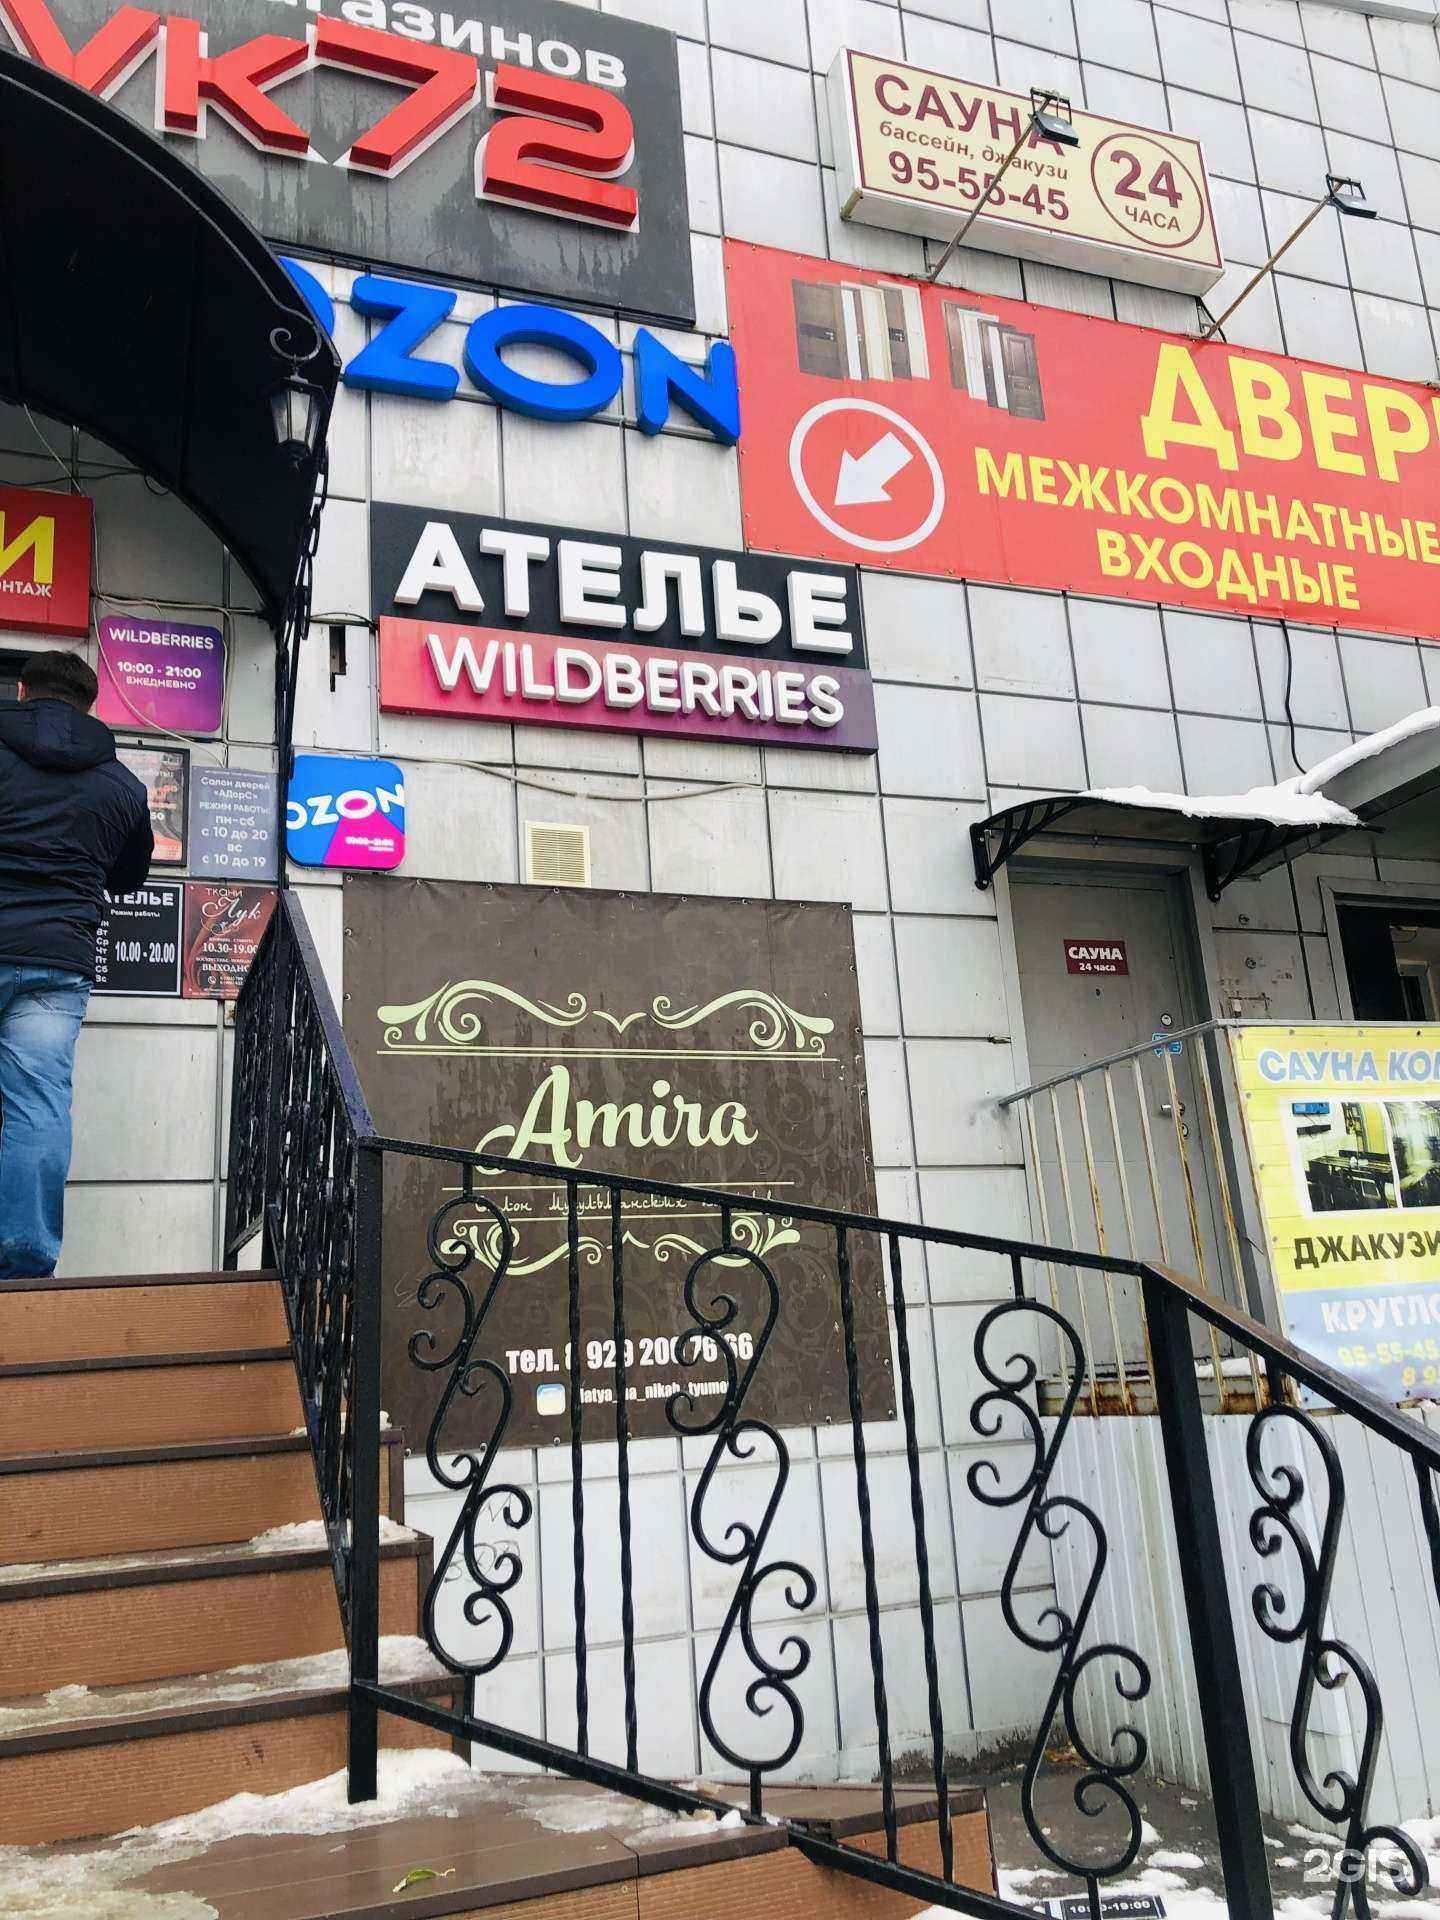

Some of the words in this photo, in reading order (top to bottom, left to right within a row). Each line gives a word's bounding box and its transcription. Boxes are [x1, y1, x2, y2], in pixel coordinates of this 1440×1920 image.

[268, 0, 627, 88] азинов
[879, 121, 975, 161] бассейн,
[982, 146, 1069, 180] джакузи
[888, 150, 1070, 221] 95-55-45
[1110, 149, 1182, 209] 24
[1125, 204, 1181, 232] ЧАСА
[974, 446, 1440, 565] МЕЖКОМНАТНЫЕ
[1096, 528, 1360, 611] ВХОДНЫЕ
[393, 520, 853, 655] АТЕЛЬЕ
[109, 627, 215, 650] WILDBERRIES
[117, 661, 154, 675] 10:00
[165, 665, 202, 679] 21:00
[126, 675, 197, 691] ЕЖЕДНЕВНО
[427, 633, 846, 728] WILDBERRIES
[200, 776, 232, 788] Салон
[213, 826, 228, 838] 10
[230, 830, 249, 842] до
[251, 829, 269, 841] 20
[213, 853, 229, 866] 10
[231, 857, 250, 868] до
[252, 855, 267, 867] 19
[115, 941, 141, 962] 10.00
[149, 942, 175, 963] 20.00
[1068, 946, 1123, 960] САУНА
[1079, 962, 1092, 971] 24
[1093, 963, 1117, 972] часа
[1259, 1049, 1379, 1083] САУНА
[1388, 1050, 1440, 1082] КО
[474, 1065, 758, 1175] Amira
[505, 1348, 559, 1374] тел.
